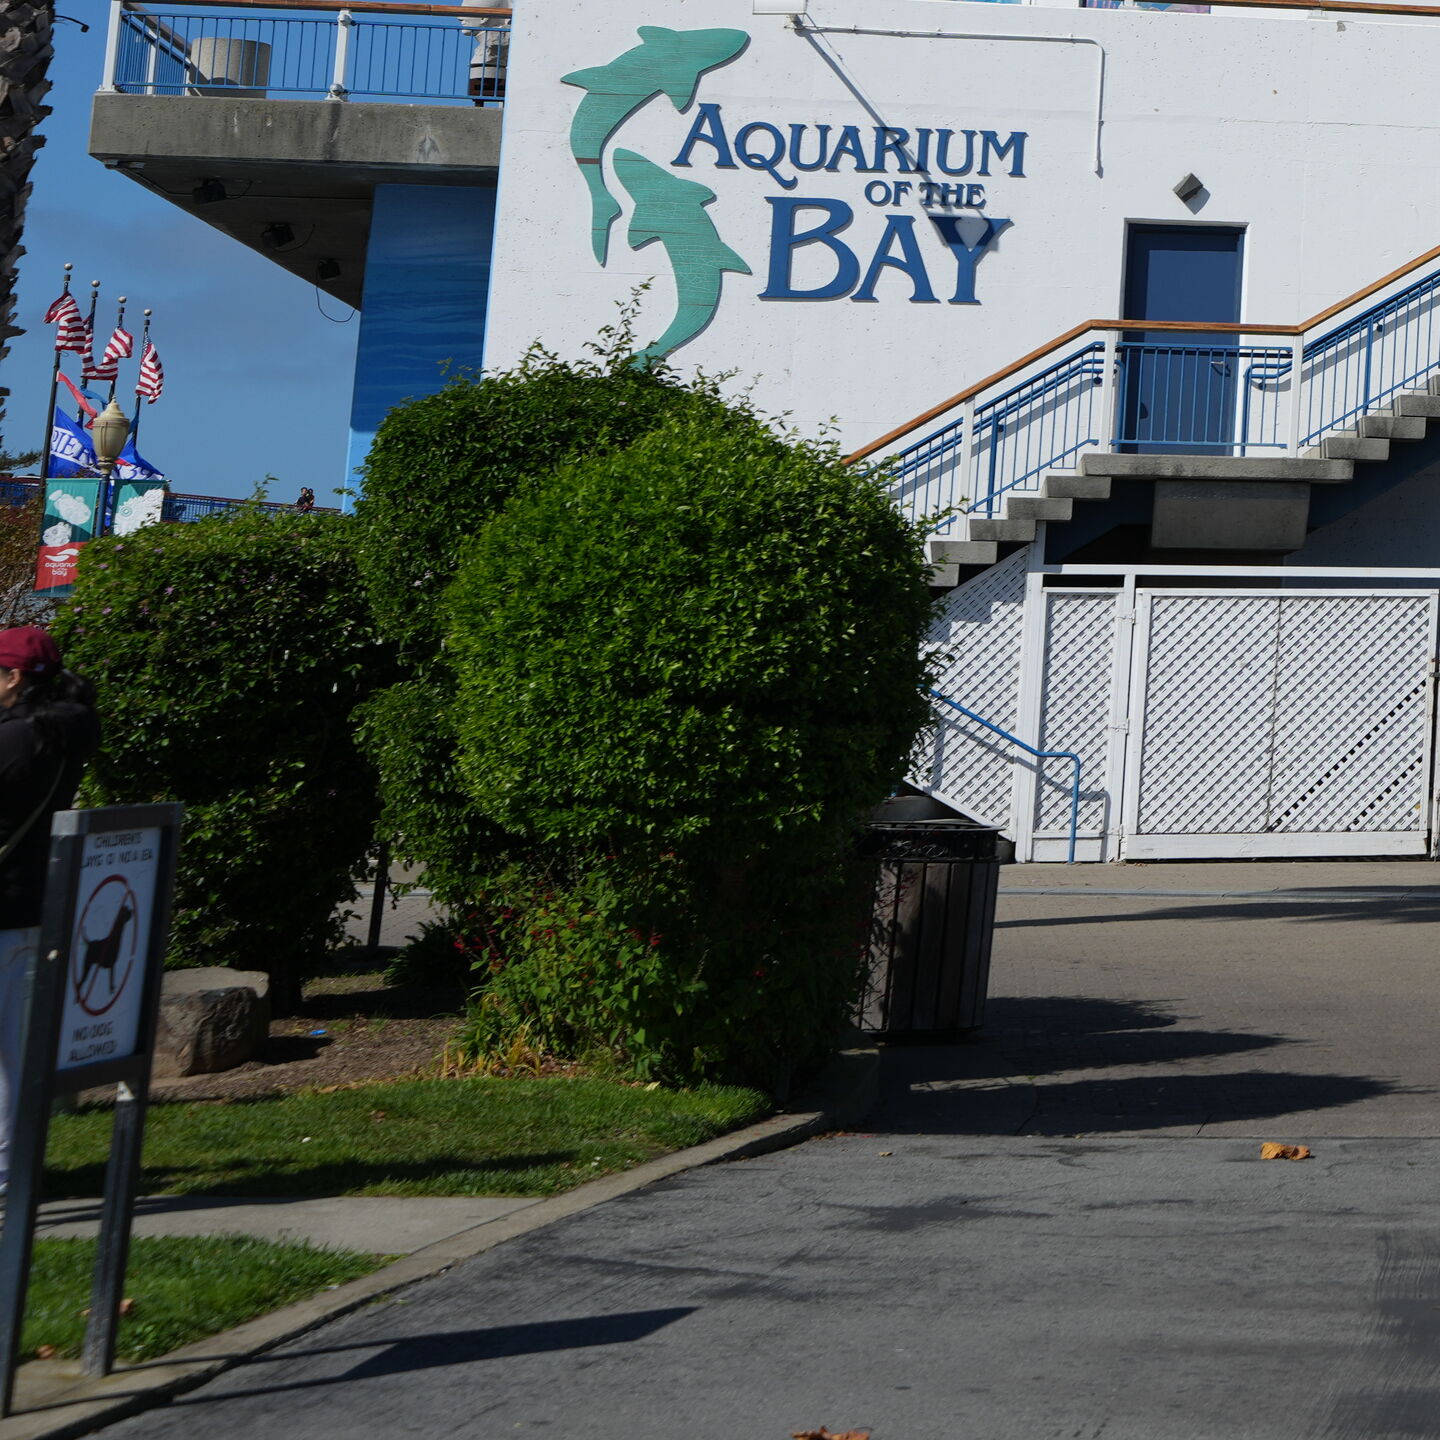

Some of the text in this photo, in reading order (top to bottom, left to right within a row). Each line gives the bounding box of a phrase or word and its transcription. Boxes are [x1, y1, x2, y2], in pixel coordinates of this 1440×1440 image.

[671, 103, 1028, 189] AQUARIUM
[864, 180, 986, 210] OF THE
[758, 196, 1013, 305] BAY
